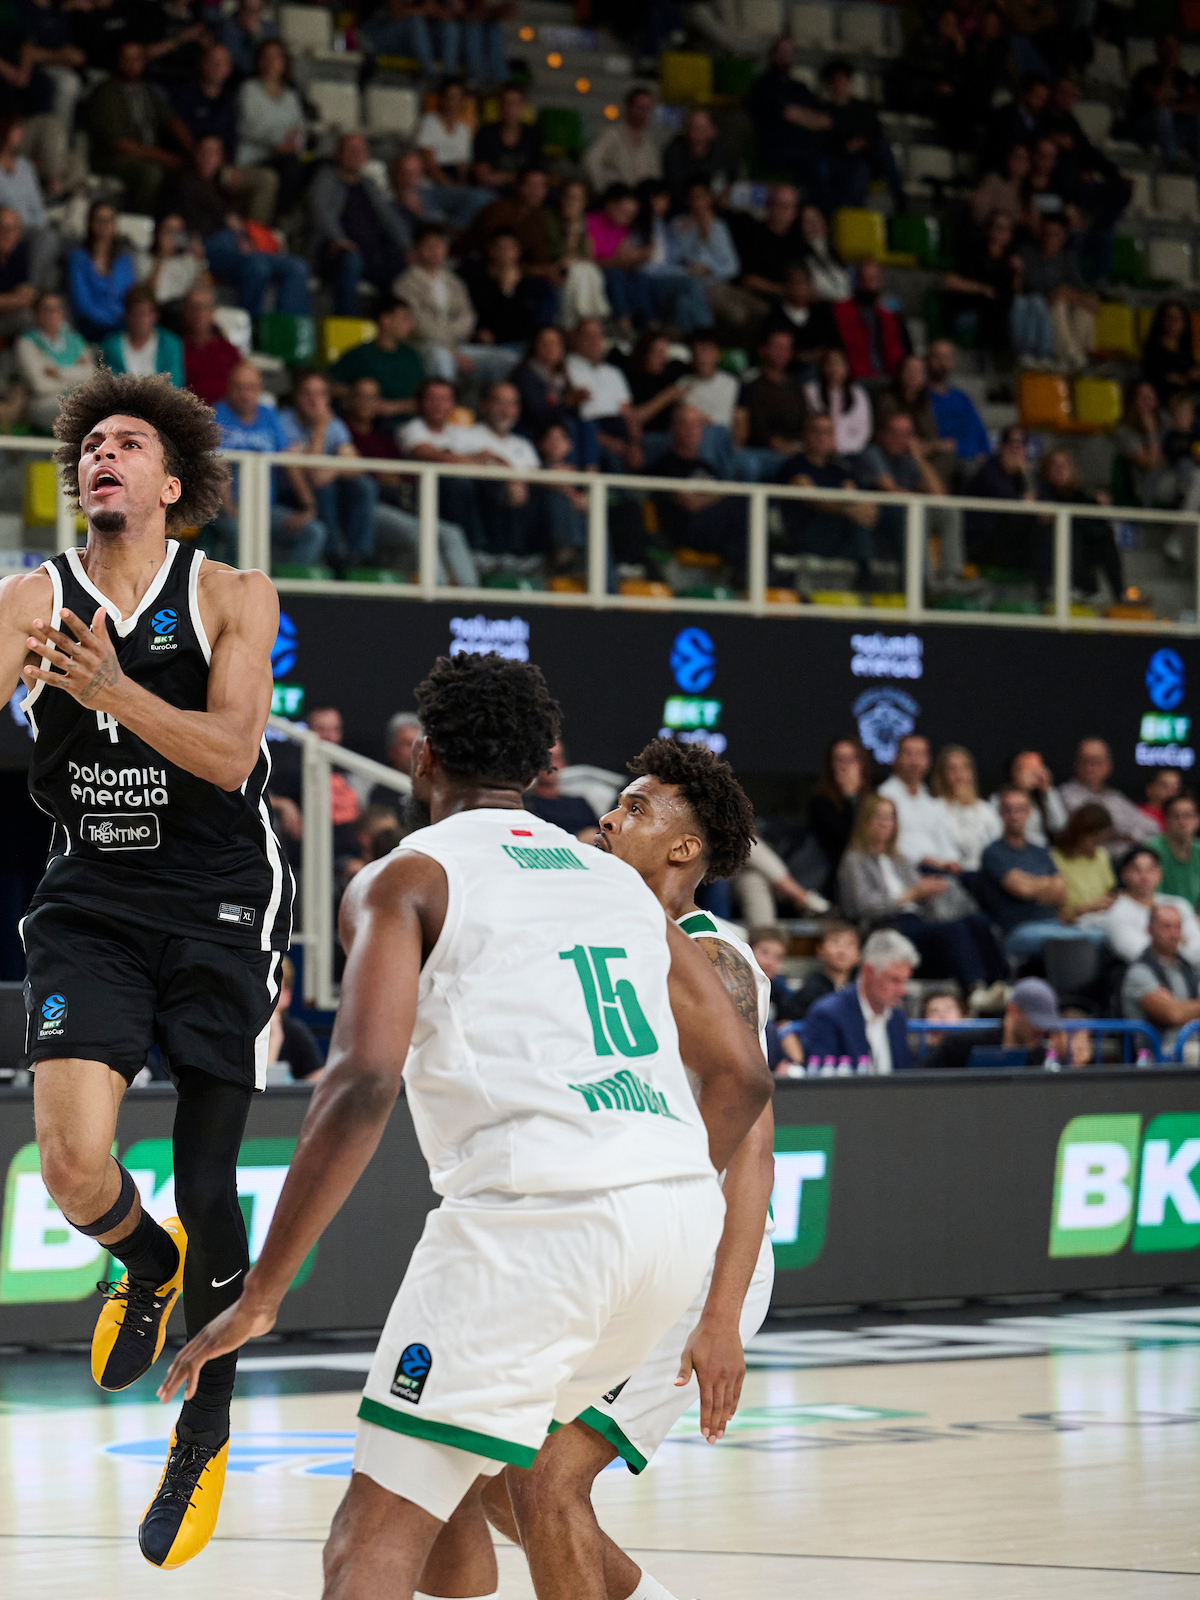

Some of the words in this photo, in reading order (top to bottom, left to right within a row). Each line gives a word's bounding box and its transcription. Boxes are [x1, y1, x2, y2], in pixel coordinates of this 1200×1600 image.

[154, 635, 174, 643] BKT
[664, 701, 721, 727] BKT
[1135, 742, 1196, 771] EuroCup
[242, 911, 252, 921] XL
[558, 944, 659, 1058] 15
[40, 1028, 64, 1036] EuroCup
[43, 1020, 61, 1029] BKT
[1057, 1138, 1200, 1231] BK
